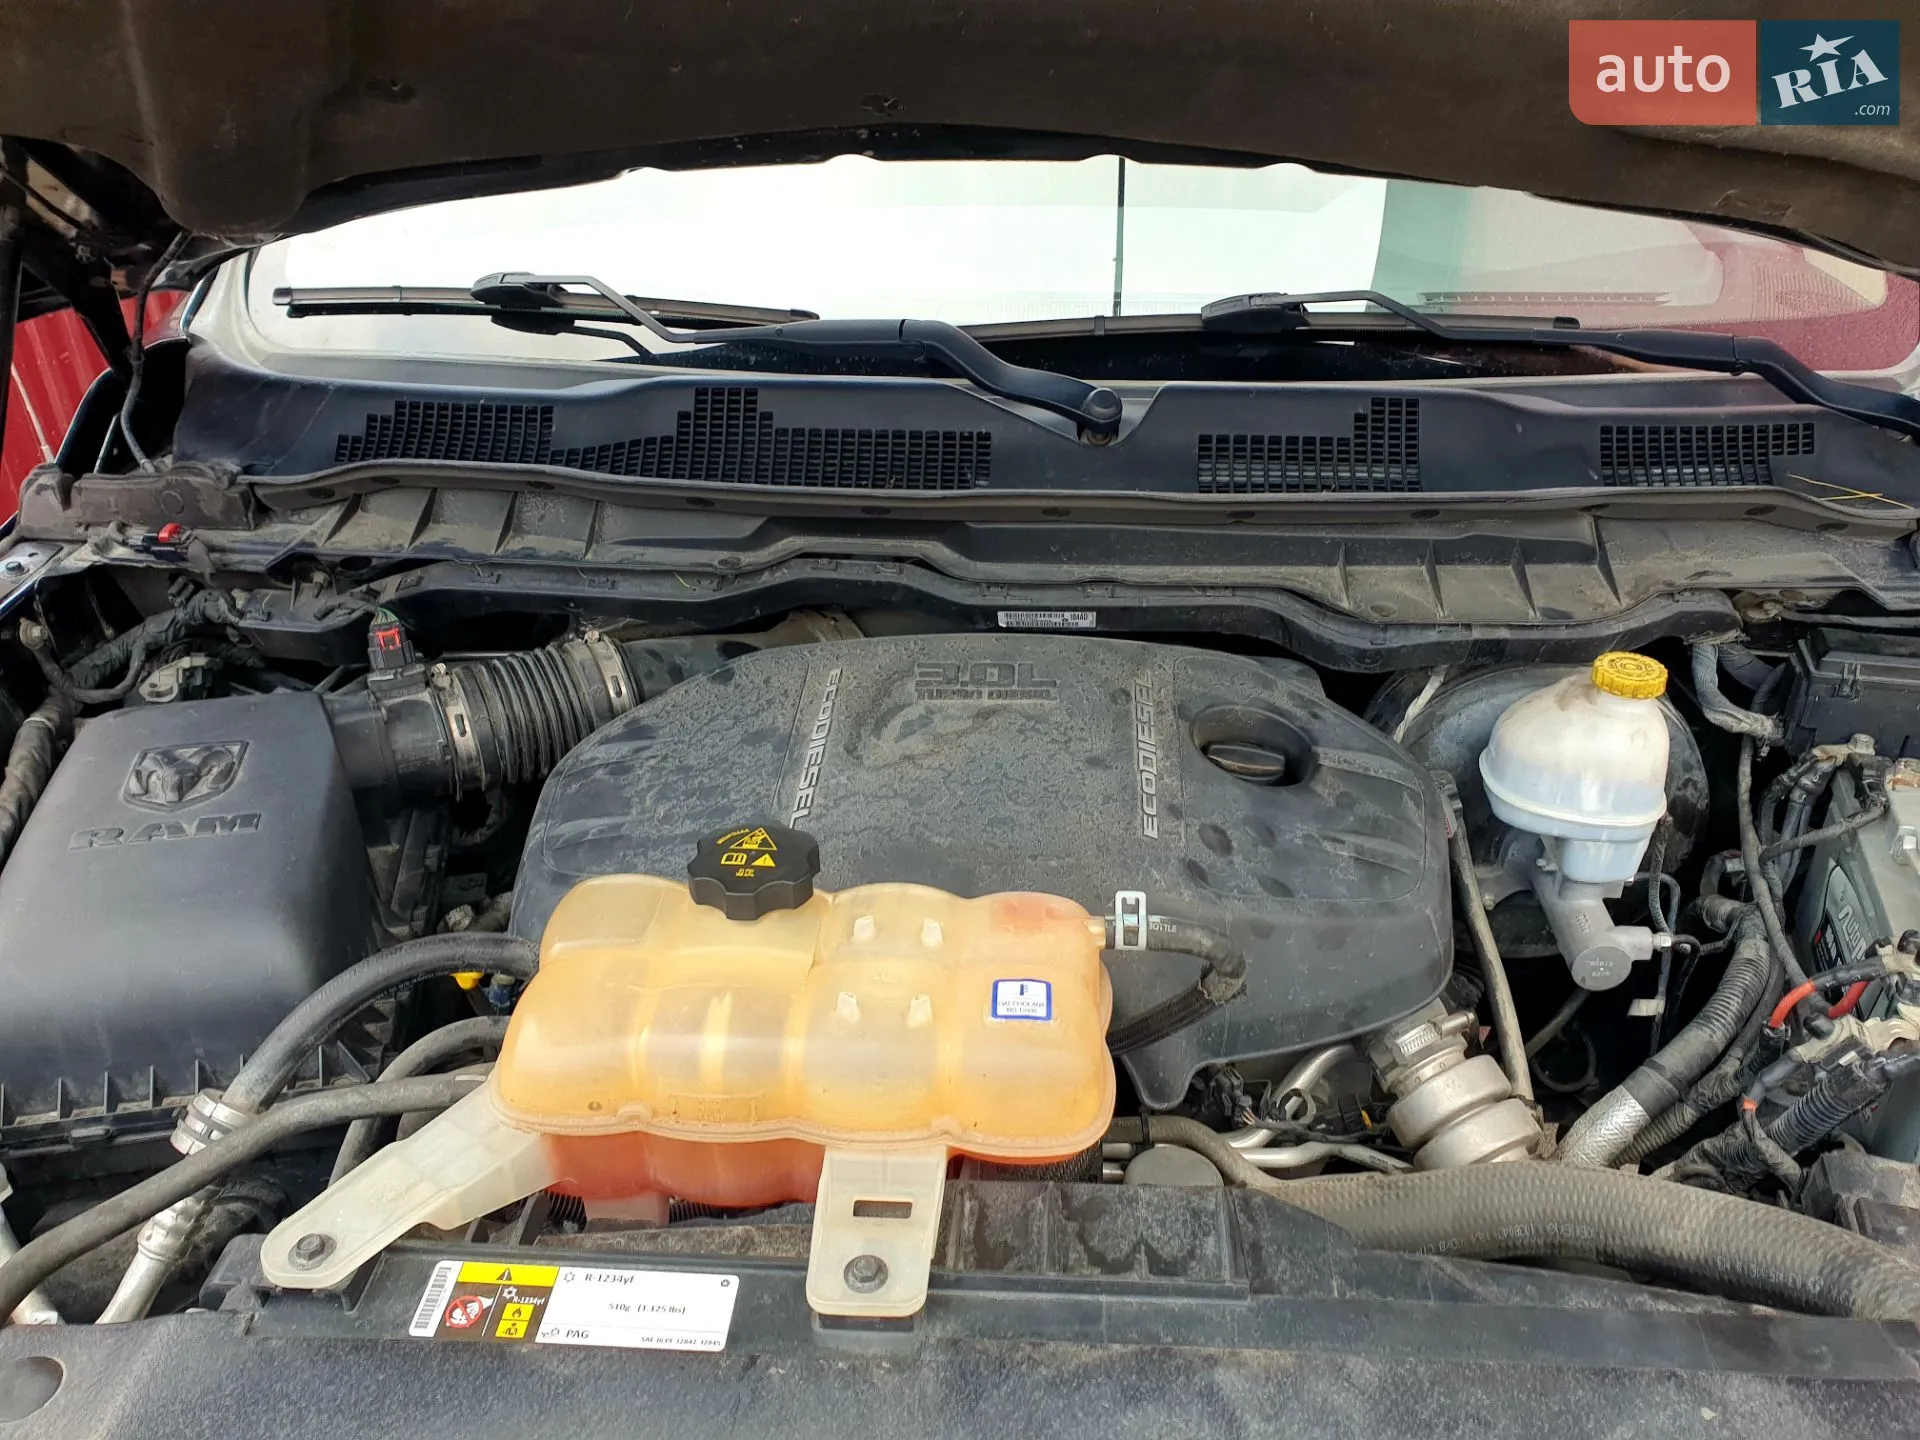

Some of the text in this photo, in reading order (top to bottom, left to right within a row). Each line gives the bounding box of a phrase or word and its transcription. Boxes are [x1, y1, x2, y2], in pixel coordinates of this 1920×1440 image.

[789, 667, 843, 830] ECODIESEL
[1134, 669, 1159, 839] ECODIESEL
[68, 812, 262, 851] RAM
[584, 1272, 635, 1285] R-1234yf
[565, 1328, 590, 1339] PAG
